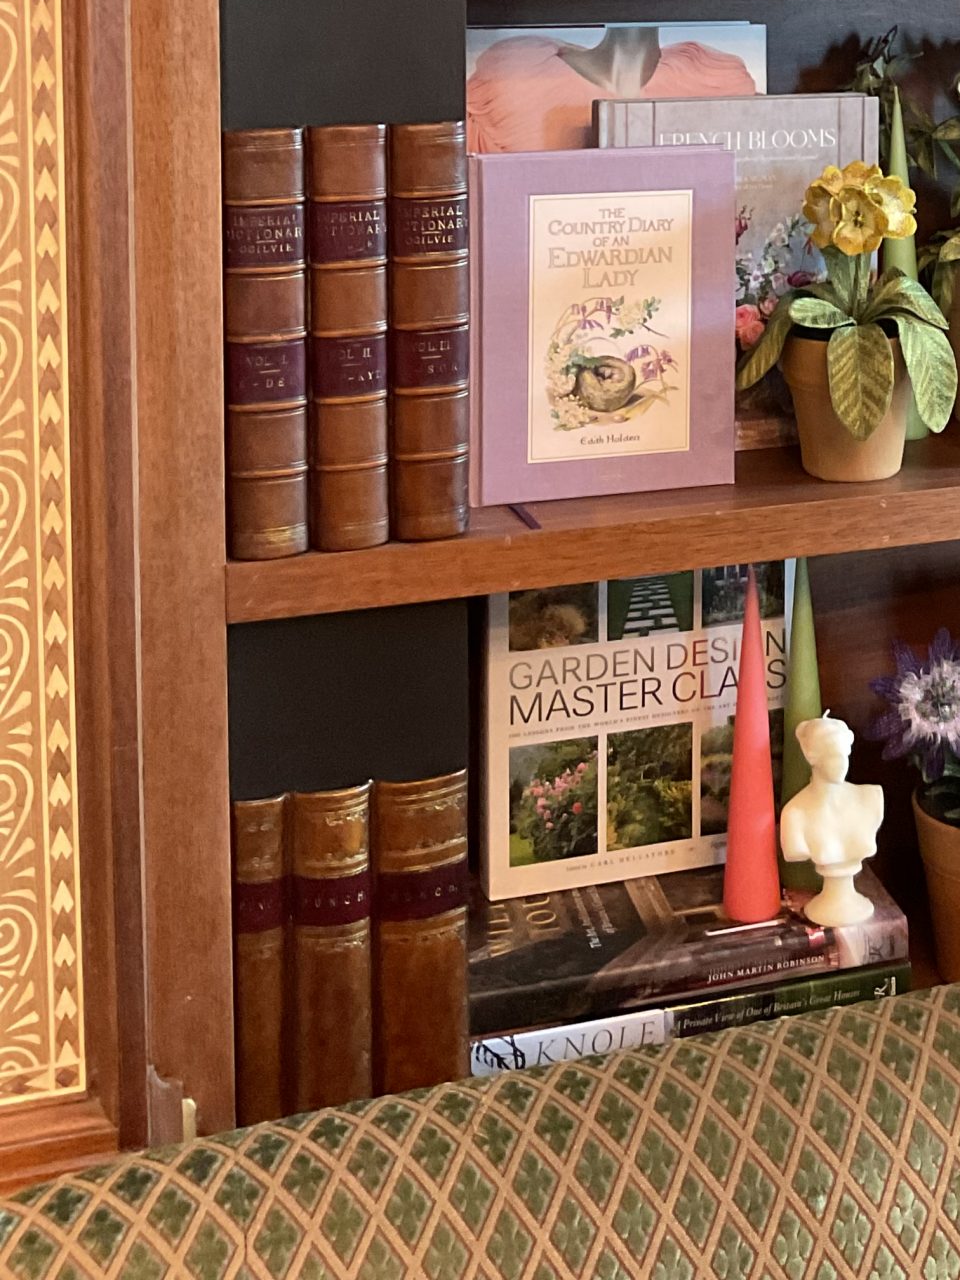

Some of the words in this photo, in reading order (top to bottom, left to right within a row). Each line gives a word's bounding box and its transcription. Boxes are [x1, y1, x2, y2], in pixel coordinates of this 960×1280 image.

[659, 130, 741, 151] FRENCH
[749, 127, 837, 151] BLOOMS
[598, 207, 626, 220] THE
[592, 236, 611, 248] OF
[612, 235, 630, 247] AN
[580, 435, 605, 445] Edith
[607, 433, 641, 444] Holden
[509, 646, 655, 691] GARDEN
[666, 630, 786, 671] DESIN
[509, 676, 663, 726] MASTER
[672, 658, 787, 703] CLAS
[707, 971, 734, 985] JOHN
[736, 964, 774, 978] MARTIN
[776, 954, 826, 970] ROBINSON
[683, 1017, 713, 1029] Private
[714, 1012, 736, 1023] View
[736, 1009, 745, 1021] of
[746, 1006, 763, 1017] One
[764, 1002, 773, 1014] of
[809, 993, 832, 1006] Great
[834, 989, 861, 1001] Houses
[537, 1020, 657, 1066] KNOLE
